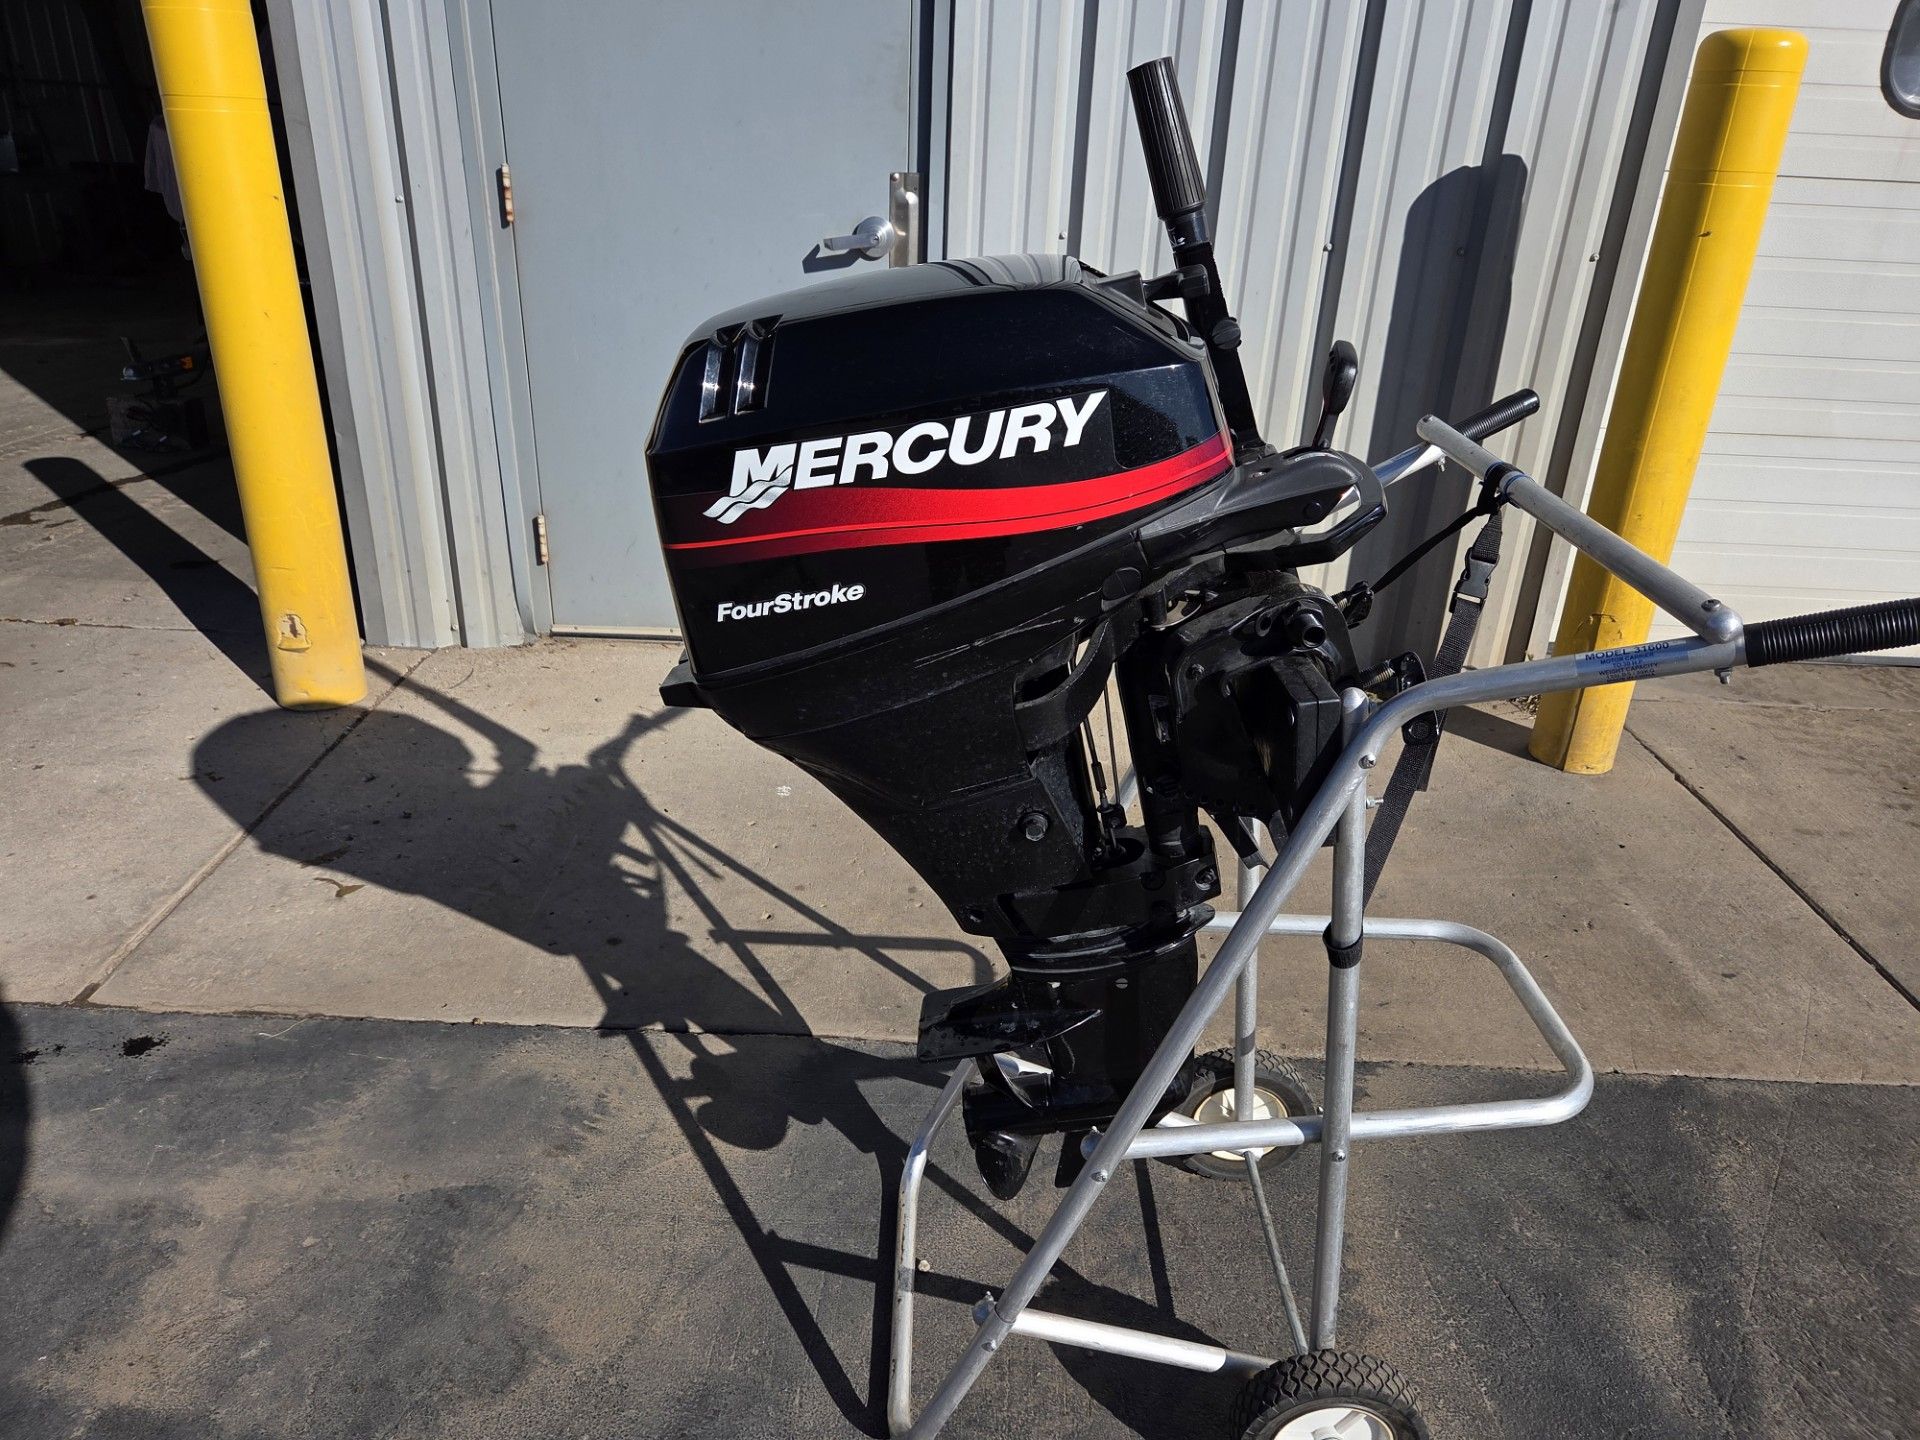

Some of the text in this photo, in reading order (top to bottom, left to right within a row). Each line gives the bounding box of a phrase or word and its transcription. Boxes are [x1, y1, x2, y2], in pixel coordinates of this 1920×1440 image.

[729, 390, 1108, 498] MERCURY
[716, 582, 866, 623] FourStroke
[1585, 648, 1629, 661] MODEL
[1599, 666, 1625, 675] WEIGHT
[1625, 662, 1659, 672] CAPACITY
